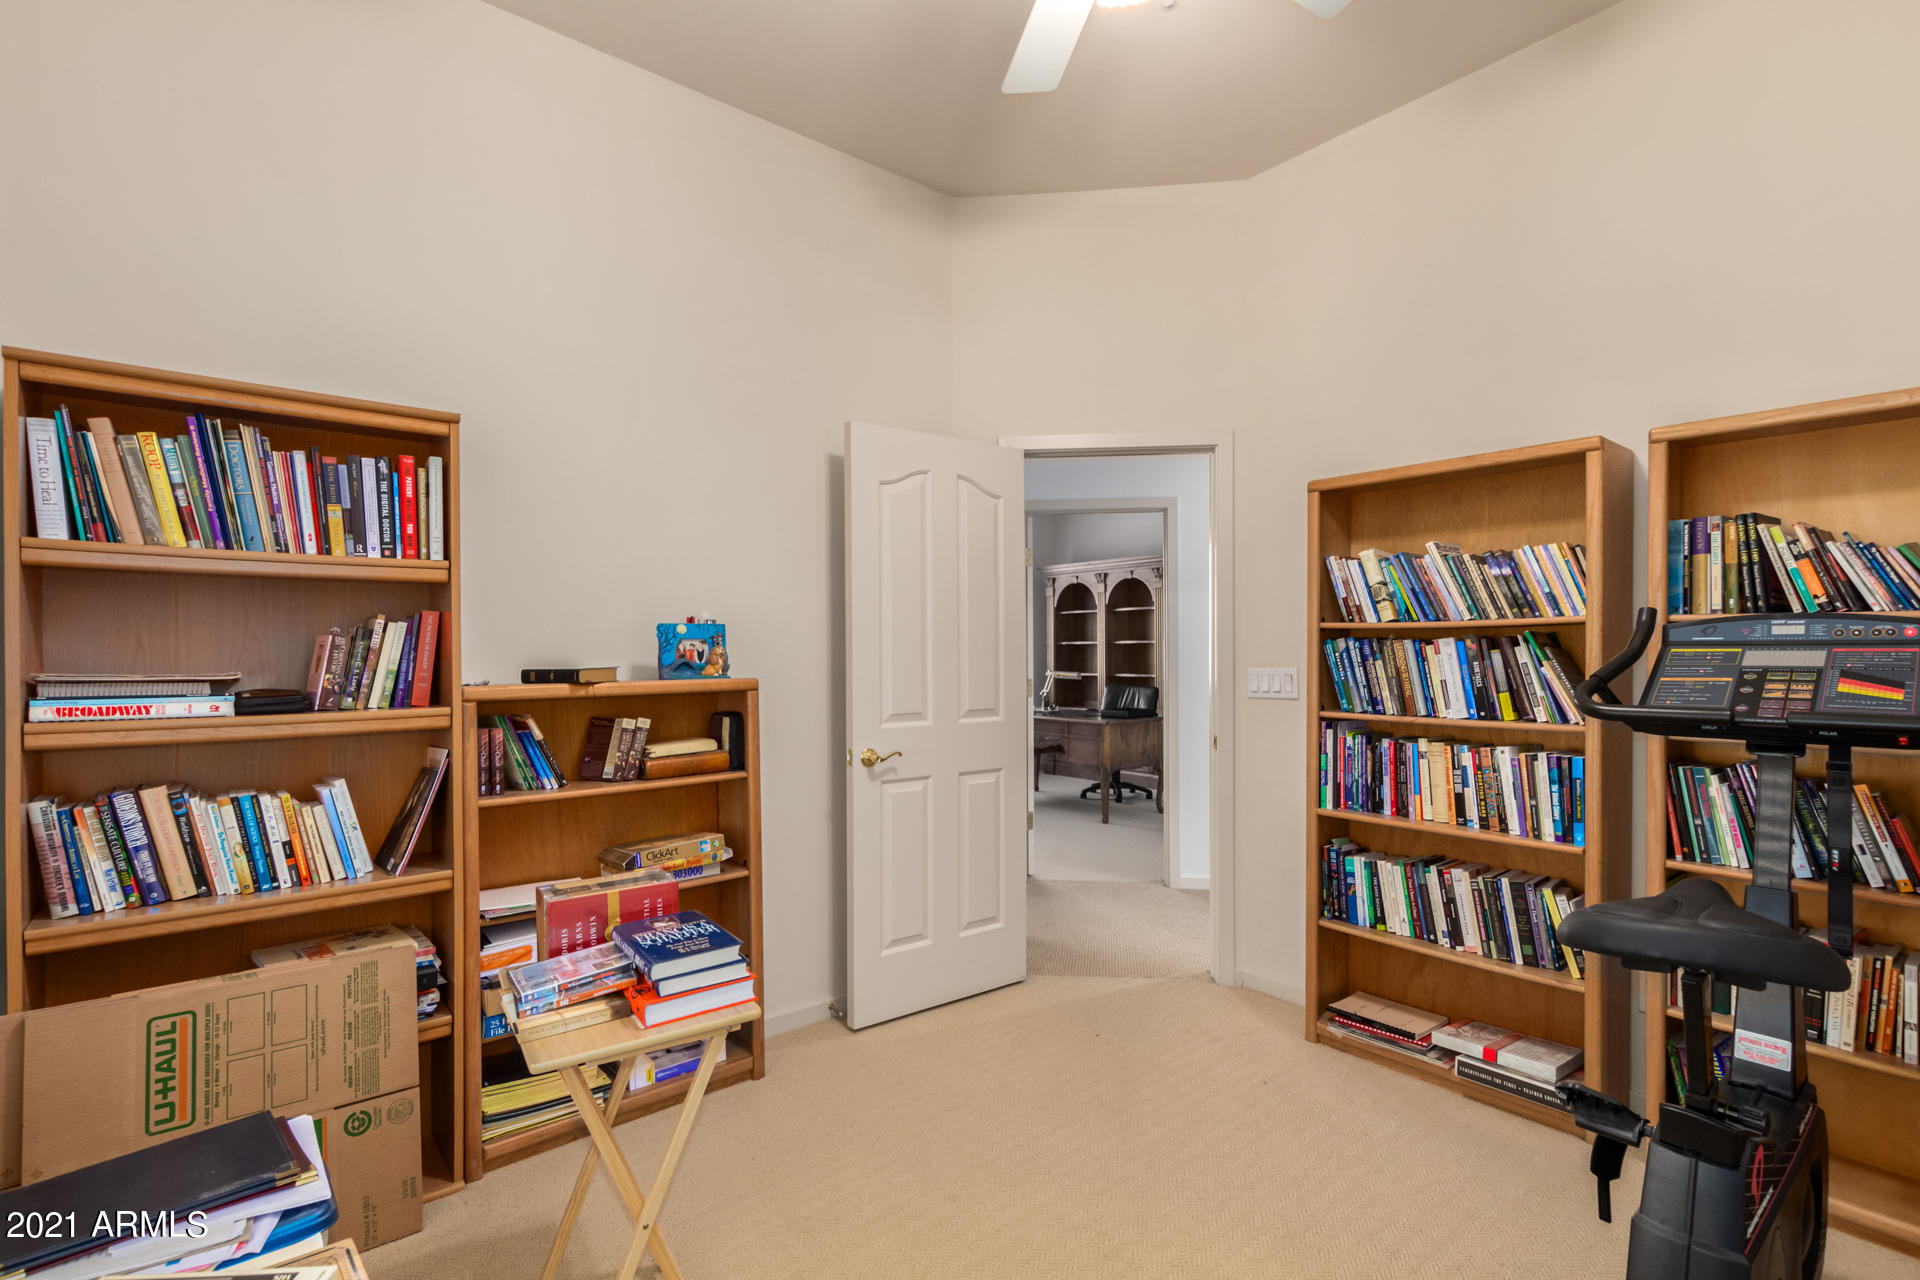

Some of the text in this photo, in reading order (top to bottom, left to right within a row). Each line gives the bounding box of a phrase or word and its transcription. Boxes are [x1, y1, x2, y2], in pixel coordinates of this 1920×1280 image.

[140, 434, 162, 470] KOOP
[35, 437, 57, 506] Time to Heal
[228, 444, 246, 490] DOCTORS
[381, 494, 390, 517] DIGITAL
[382, 518, 390, 543] DOCTOR
[1696, 521, 1704, 550] HEAVEN
[1712, 533, 1720, 544] THE
[1396, 642, 1408, 672] LEARNING
[1402, 681, 1411, 698] HEAL
[1477, 770, 1485, 800] ABORTION
[113, 793, 148, 848] GIDEON'S TORCH
[178, 816, 191, 843] Worldview
[39, 806, 55, 832] CHRISTIAN
[52, 864, 64, 891] TEACHER'S
[100, 811, 128, 871] SENSATE CULTURE
[646, 847, 679, 861] ClickArt
[561, 928, 569, 956] DORIS
[490, 1020, 500, 1028] 25
[490, 1026, 506, 1036] File
[154, 1020, 177, 1126] U-HAUL
[1504, 1080, 1517, 1090] TIMES
[1544, 1094, 1564, 1105] EDITIO
